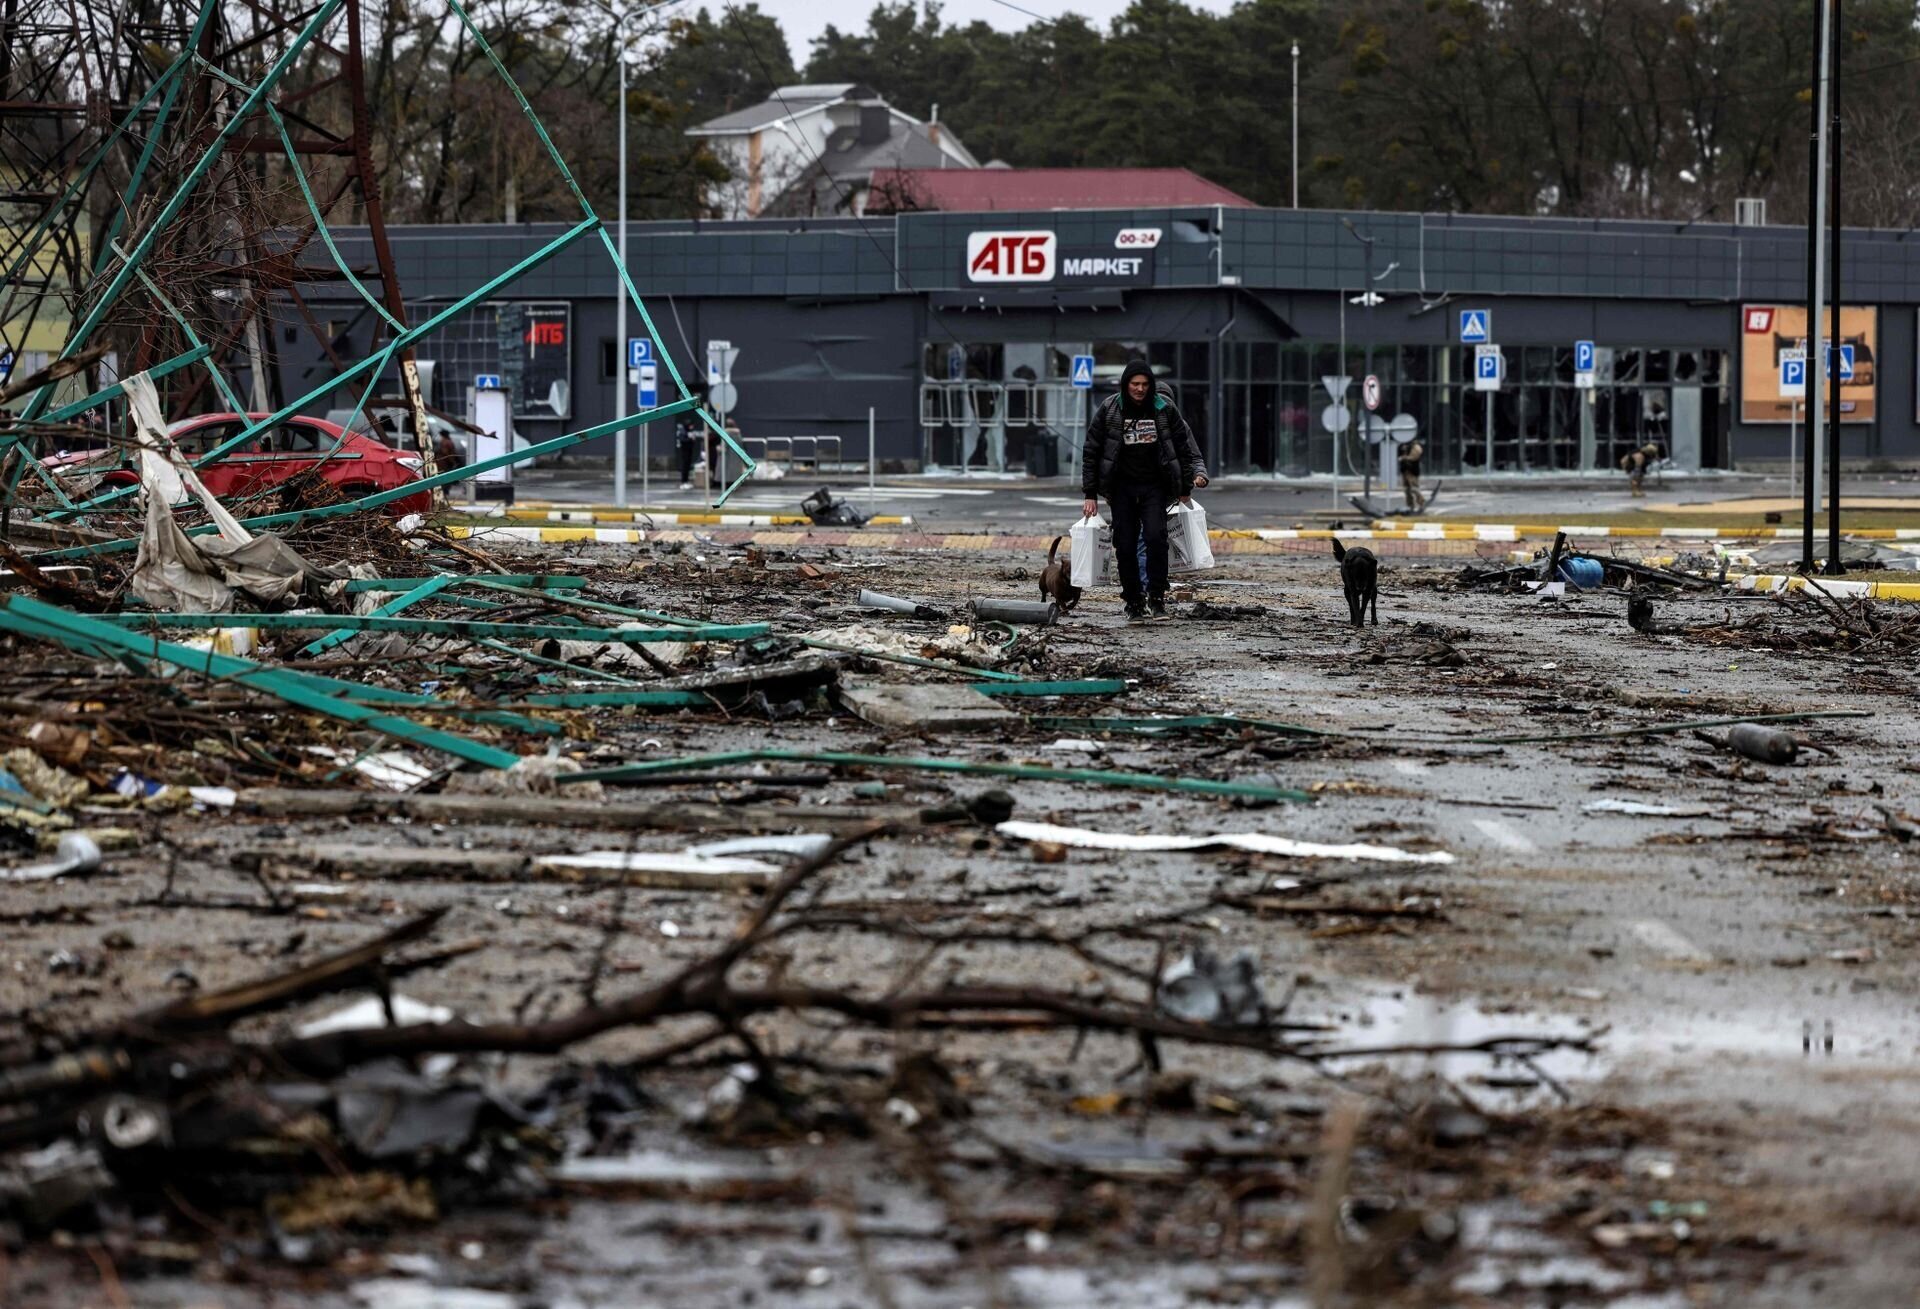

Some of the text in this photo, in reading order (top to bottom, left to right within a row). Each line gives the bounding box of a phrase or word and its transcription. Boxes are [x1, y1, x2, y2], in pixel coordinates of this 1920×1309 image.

[1119, 233, 1156, 244] 00-24
[972, 237, 1143, 275] АТБ МАРКЕТ
[525, 323, 564, 344] АТБ
[634, 342, 646, 366] P
[1579, 345, 1590, 368] P
[1482, 358, 1494, 376] P
[1788, 363, 1800, 383] P
